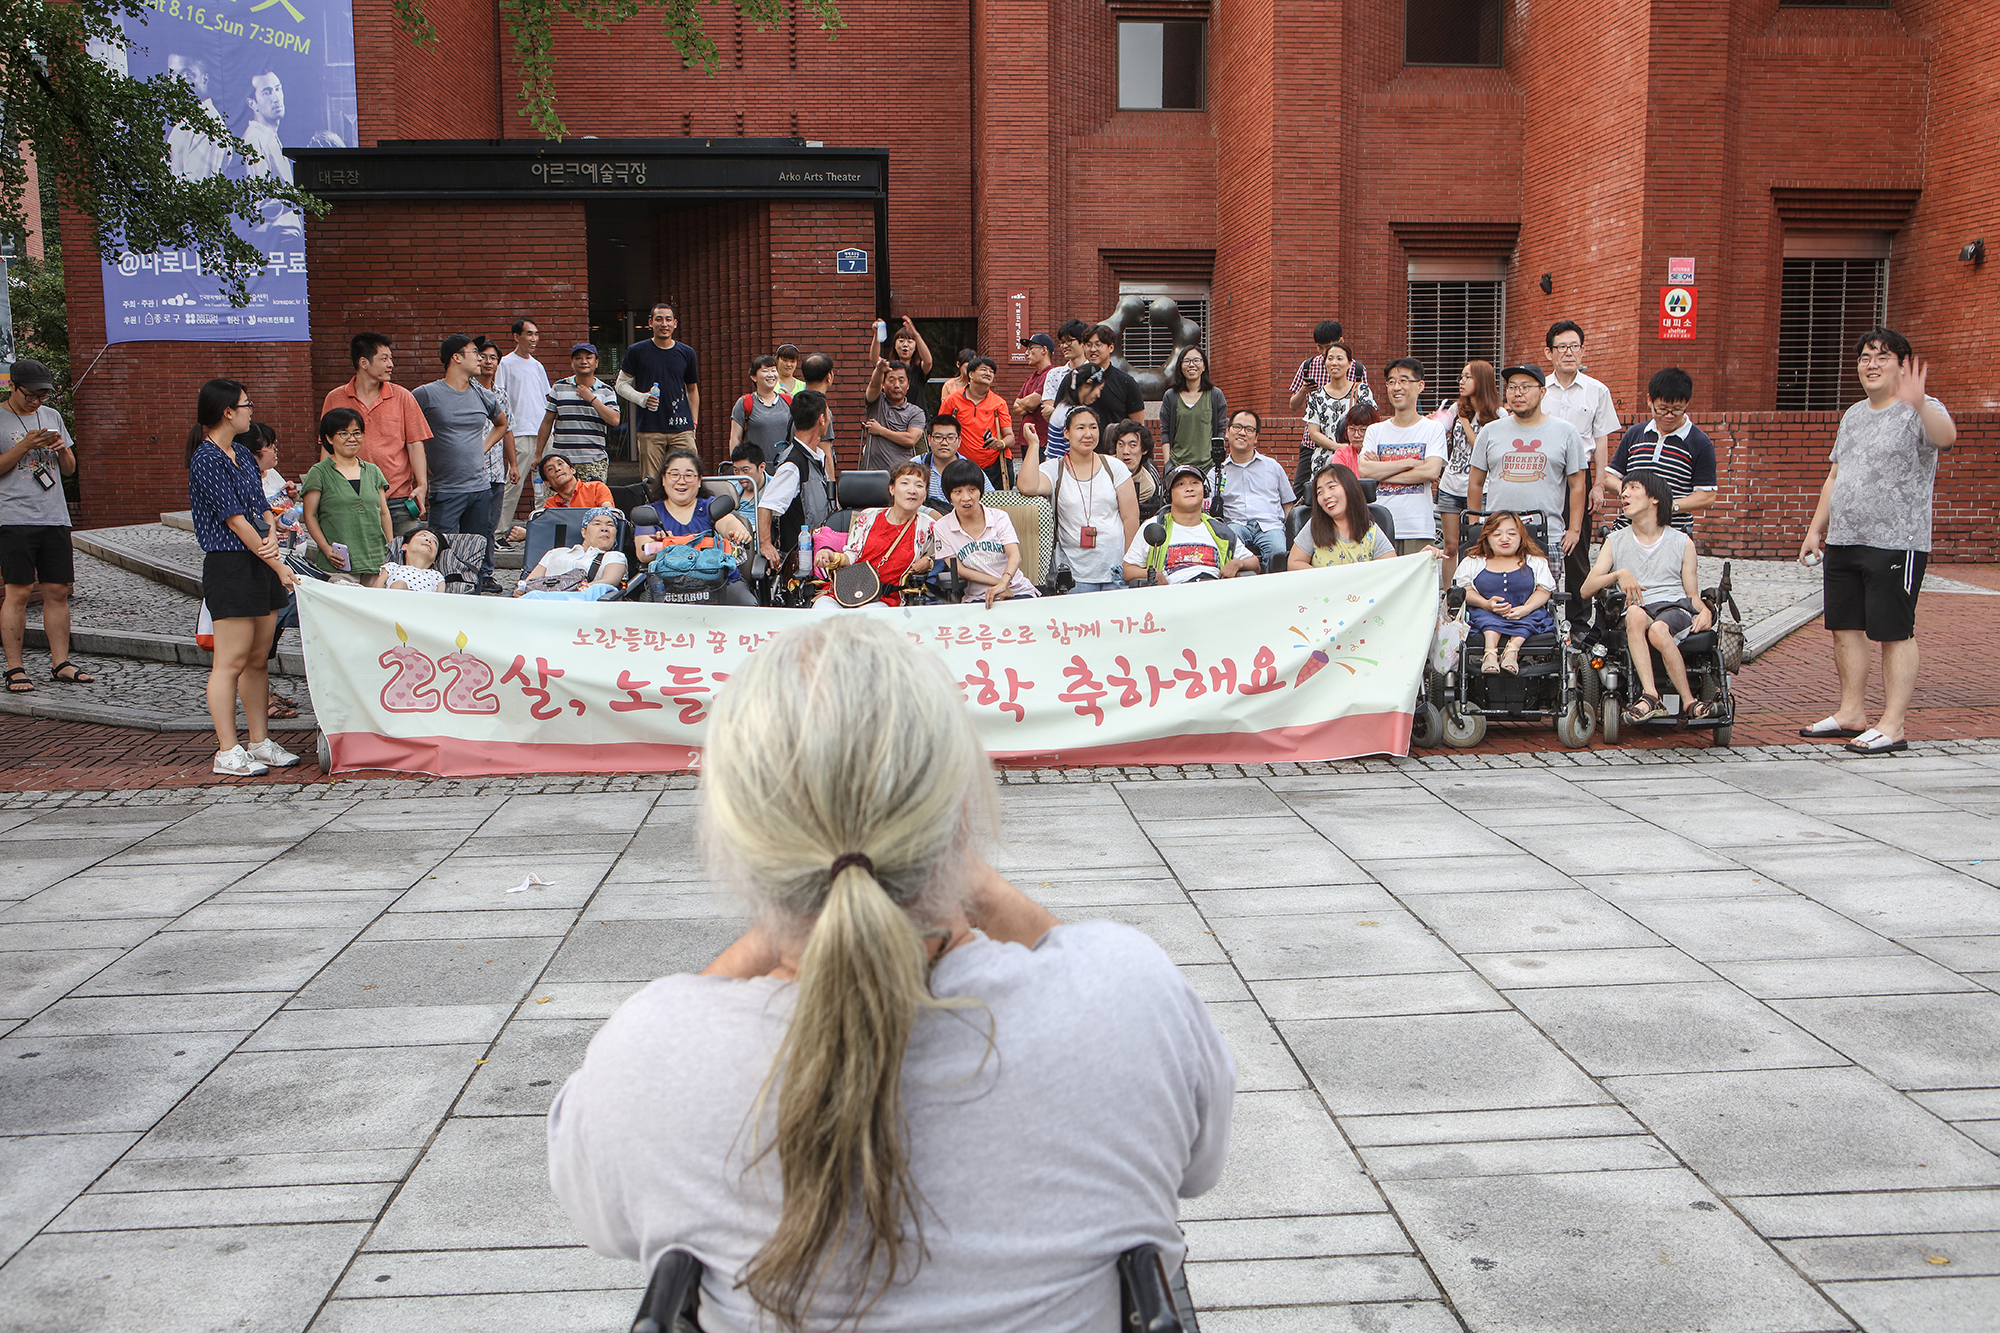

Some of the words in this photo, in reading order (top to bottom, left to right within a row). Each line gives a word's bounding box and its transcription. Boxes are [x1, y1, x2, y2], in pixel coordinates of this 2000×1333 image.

[249, 23, 311, 55] 7:30PM
[318, 170, 360, 185] 대극장
[779, 172, 801, 182] Arko
[803, 172, 823, 182] Arts
[825, 172, 861, 182] Theater
[267, 251, 308, 277] 무료
[848, 260, 856, 271] 7
[154, 313, 181, 324] 종로구
[1504, 454, 1545, 463] MICKEY'S
[572, 626, 695, 653] 노란들판의
[706, 630, 728, 654] 꿈
[935, 624, 1037, 651] 푸르름으로
[1046, 618, 1101, 645] 함께
[1057, 645, 1288, 727] 축하해요
